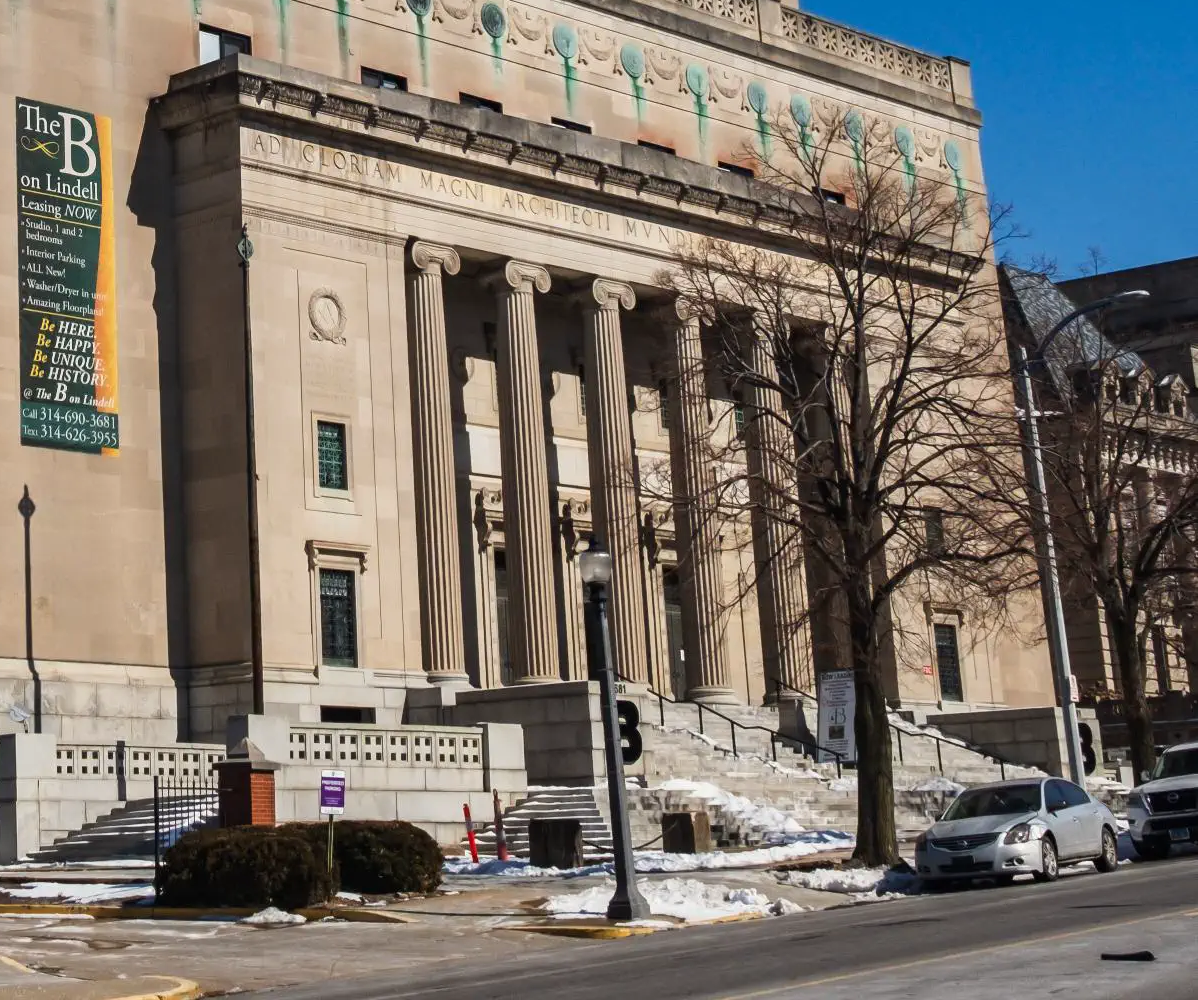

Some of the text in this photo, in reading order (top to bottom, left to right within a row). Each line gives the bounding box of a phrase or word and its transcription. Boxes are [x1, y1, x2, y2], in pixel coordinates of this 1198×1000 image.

[19, 104, 97, 177] The B
[254, 135, 281, 155] AD
[420, 171, 484, 203] MAGNI
[20, 173, 98, 200] on Lindell
[21, 195, 97, 221] Leasing NOW
[25, 230, 63, 245] bedrooms
[62, 226, 76, 237] and
[78, 228, 83, 237] 2
[26, 246, 86, 268] Interior Parking
[26, 263, 66, 278] ALL New!
[27, 278, 80, 297] Washer/Dryer
[81, 288, 89, 298] in
[27, 296, 60, 312] Amazing
[40, 318, 97, 339] Be HERE.
[36, 334, 52, 348] Be
[33, 350, 48, 363] Be
[30, 365, 45, 378] Be
[35, 387, 52, 400] The
[53, 382, 68, 402] B
[69, 395, 81, 404] on
[83, 394, 115, 408] Lindell
[22, 407, 116, 429] Call 314-690-3681
[22, 424, 117, 446] Text 314-626-3955
